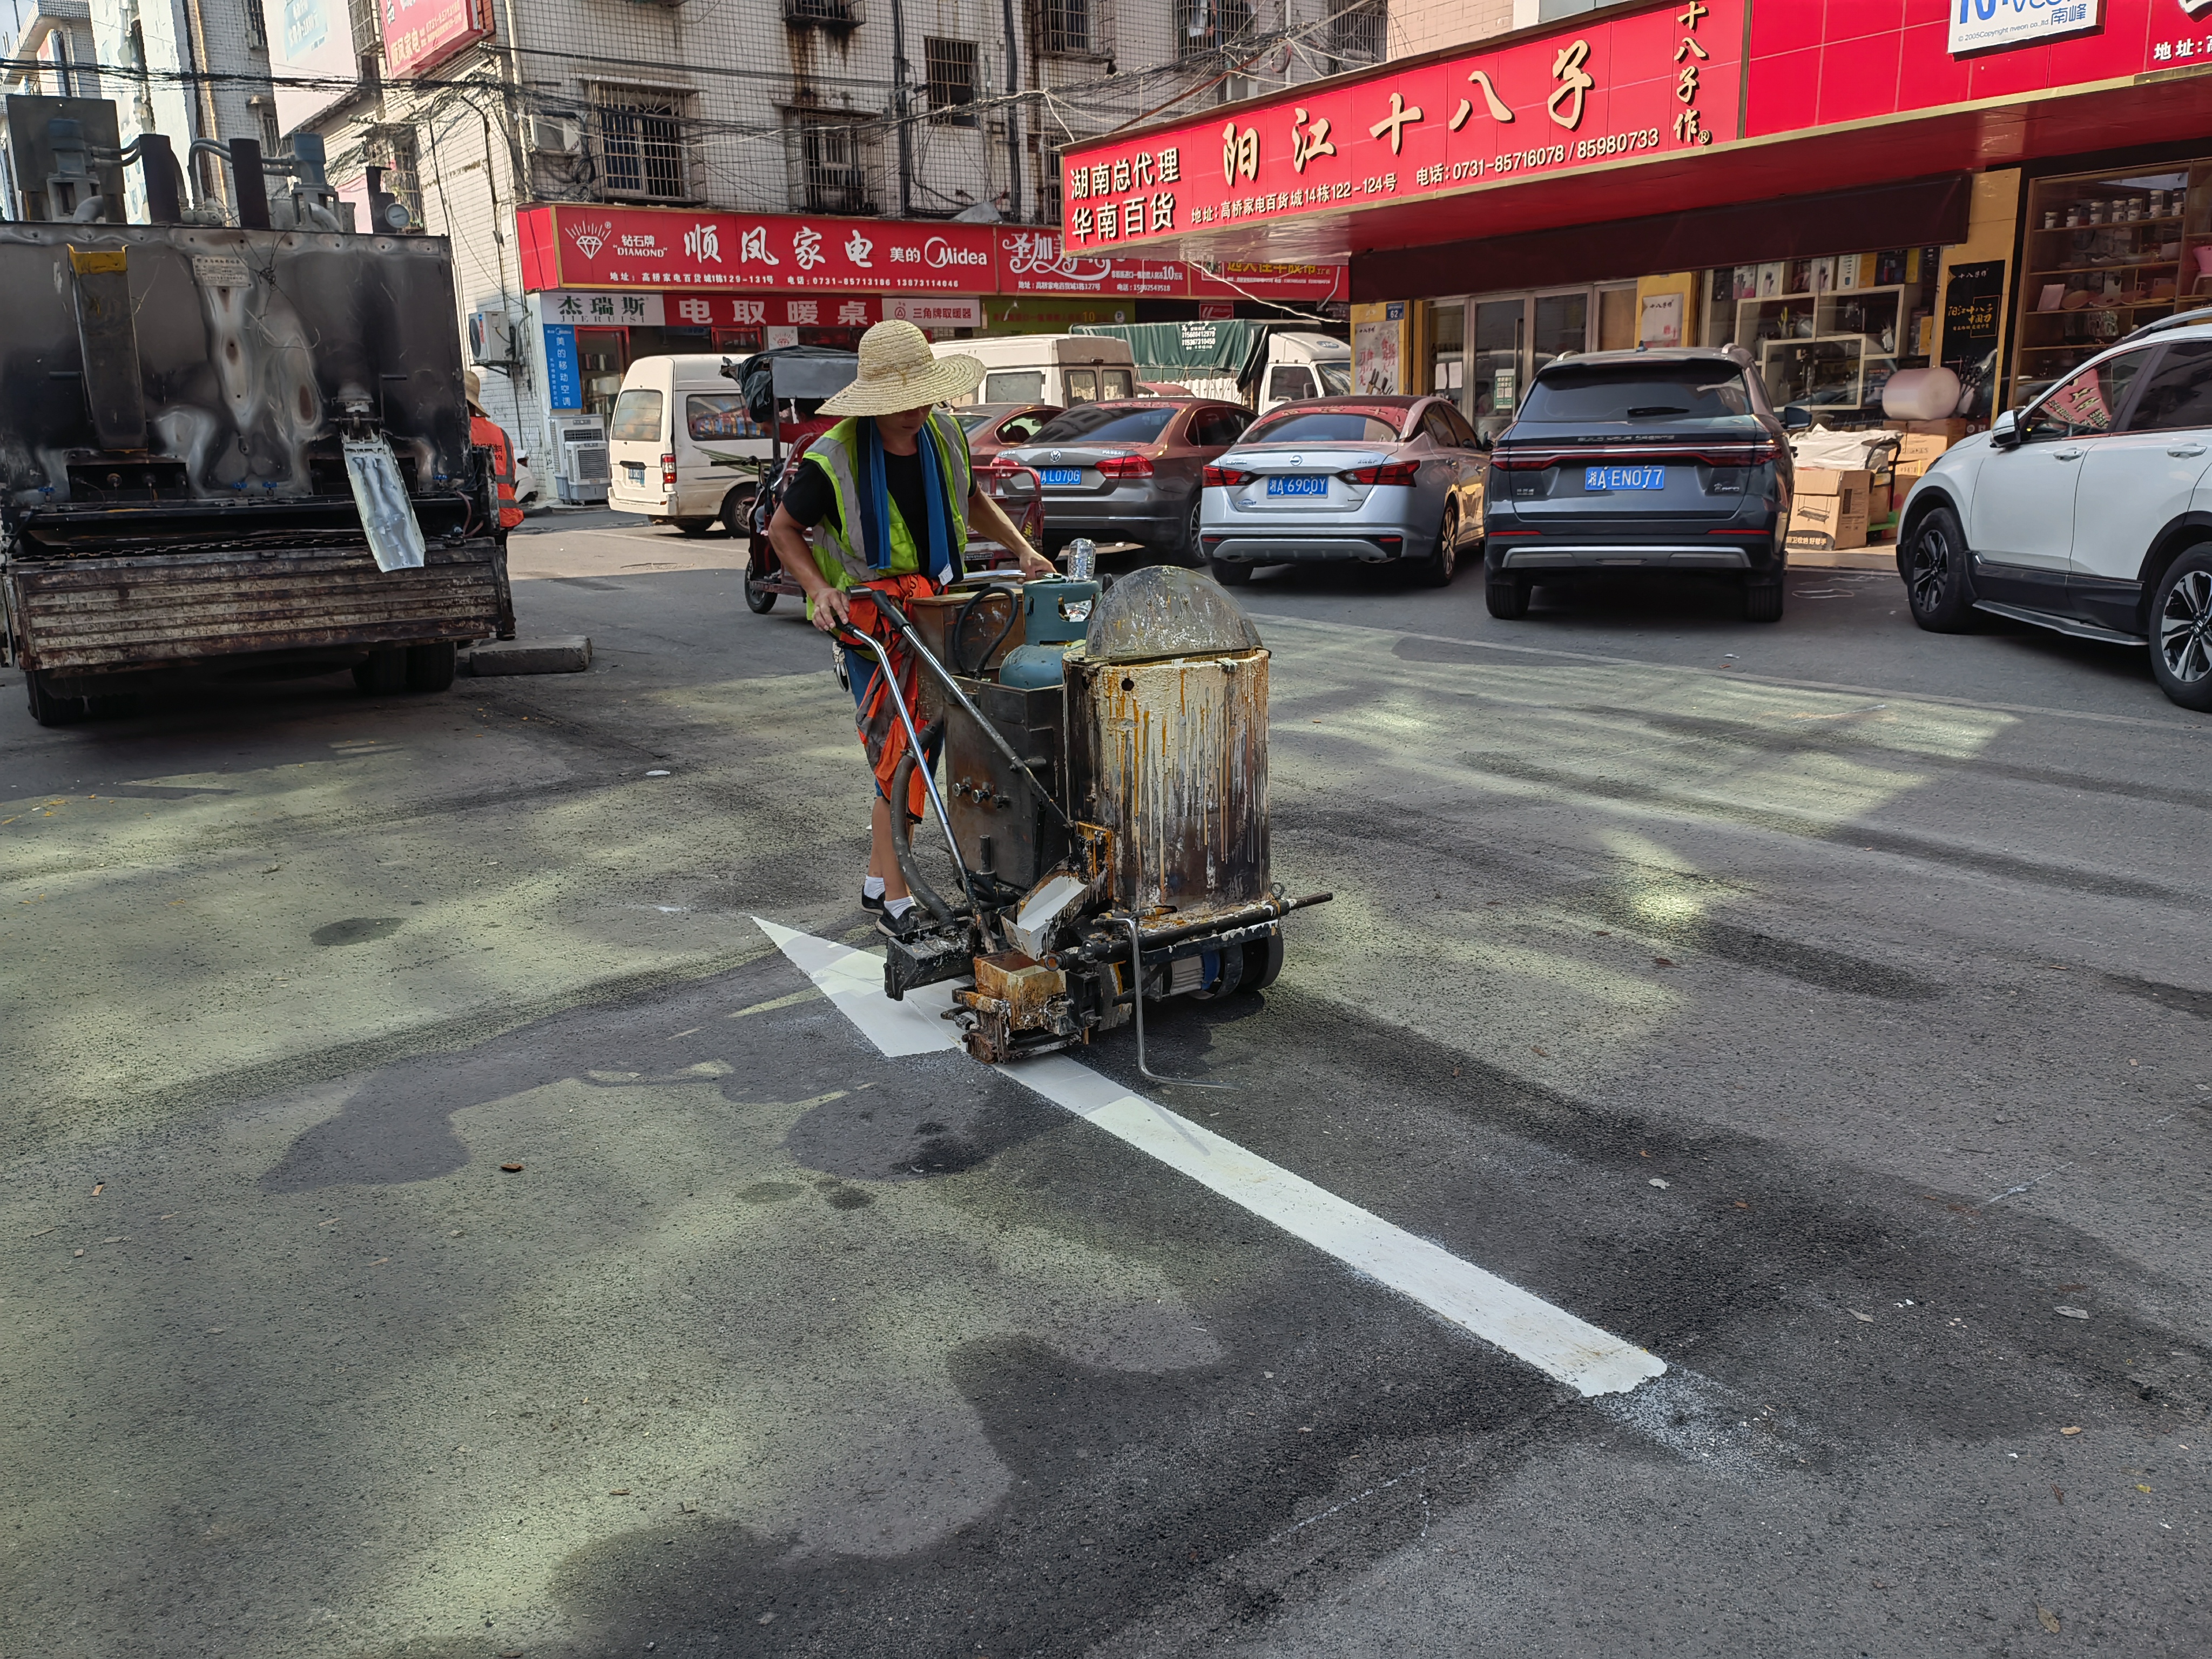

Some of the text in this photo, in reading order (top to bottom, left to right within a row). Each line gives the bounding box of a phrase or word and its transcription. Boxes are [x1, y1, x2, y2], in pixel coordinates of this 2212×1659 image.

[2051, 3, 2087, 25] 南峰
[1221, 39, 1595, 187] 阳江十八子
[1070, 146, 1181, 201] 湖南总代理
[1071, 191, 1176, 245] 华南百货
[621, 234, 655, 248] 钻石牌
[889, 247, 920, 264] 美的
[931, 243, 987, 268] Midea
[557, 295, 645, 316] 杰瑞斯
[679, 299, 868, 326] 电取暖桌
[913, 307, 972, 319] 三角牌取暖器
[1390, 310, 1399, 318] 62
[1948, 304, 1993, 316] 阳江十八子
[556, 336, 571, 406] 美的移动空调
